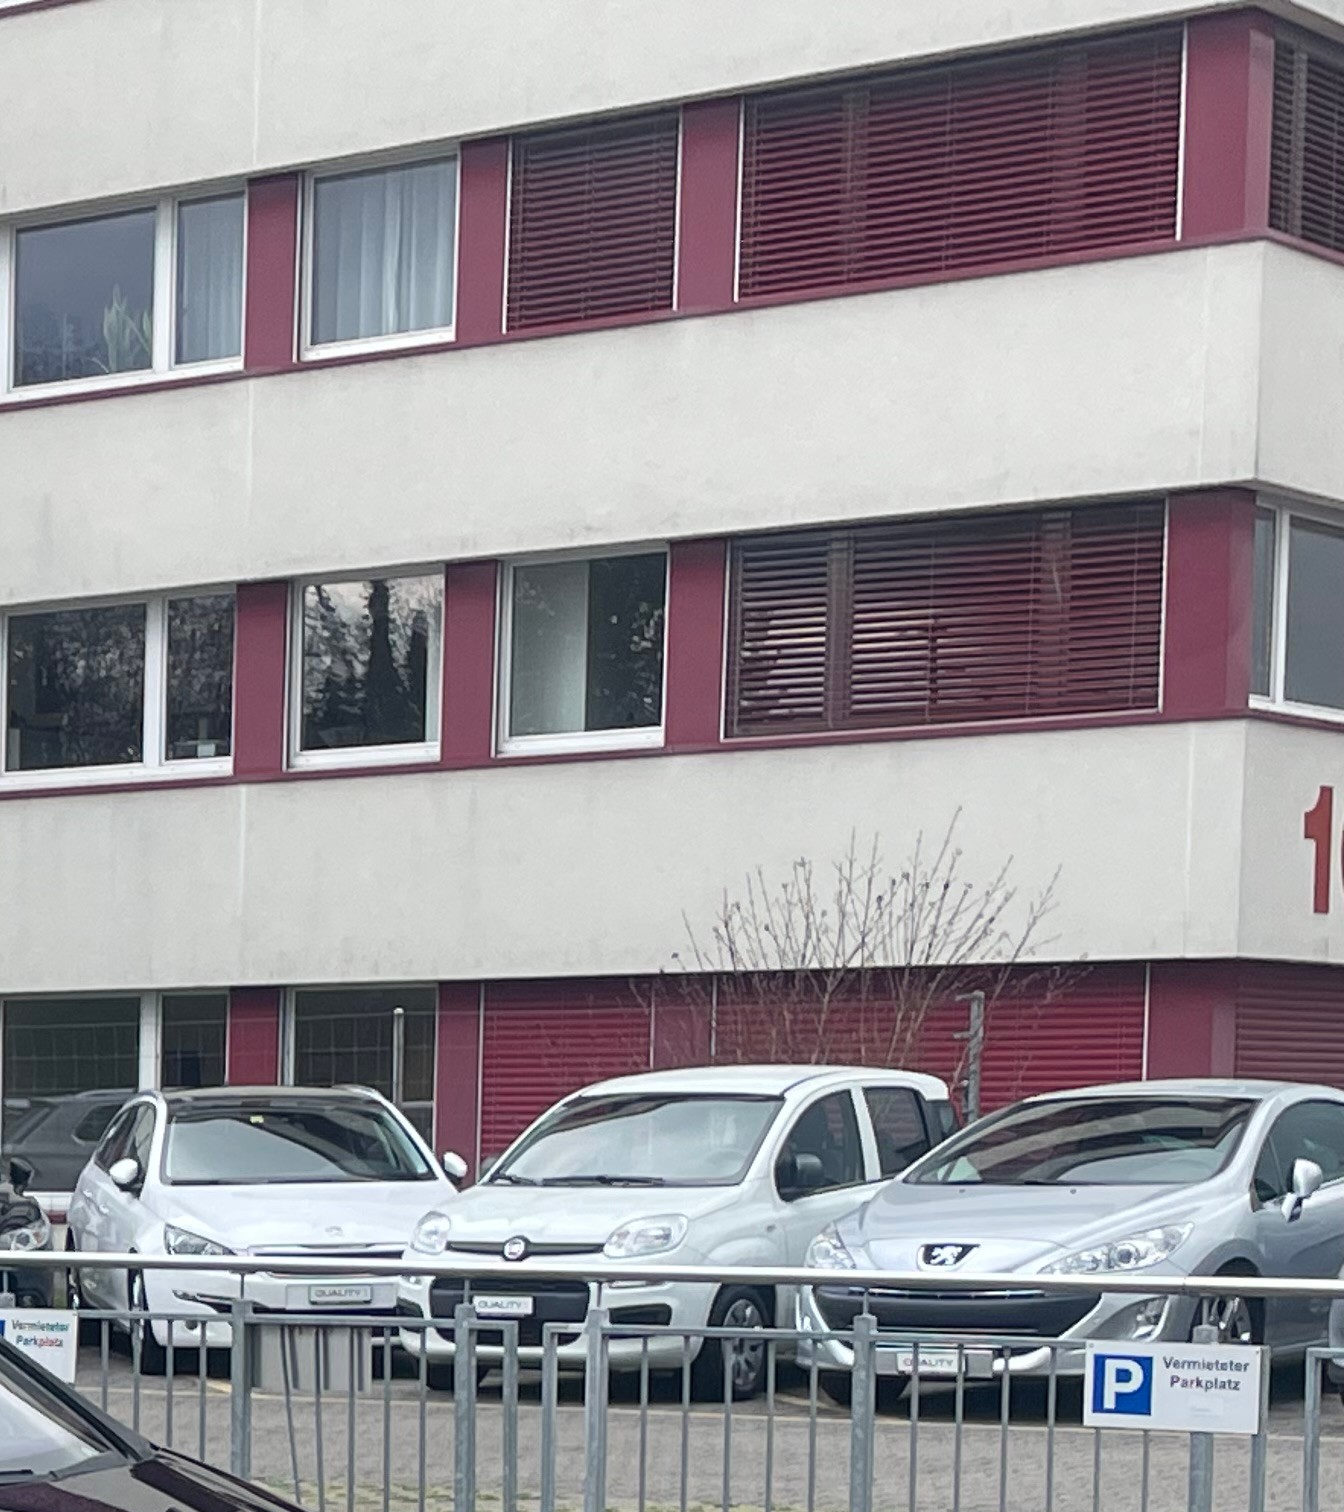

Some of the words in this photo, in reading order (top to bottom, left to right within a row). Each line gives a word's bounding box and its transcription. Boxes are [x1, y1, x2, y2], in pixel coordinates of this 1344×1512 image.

[1303, 785, 1344, 914] 1
[1162, 1356, 1250, 1373] Vermieteter
[1102, 1359, 1145, 1410] P
[1169, 1374, 1241, 1392] Parkplatz
